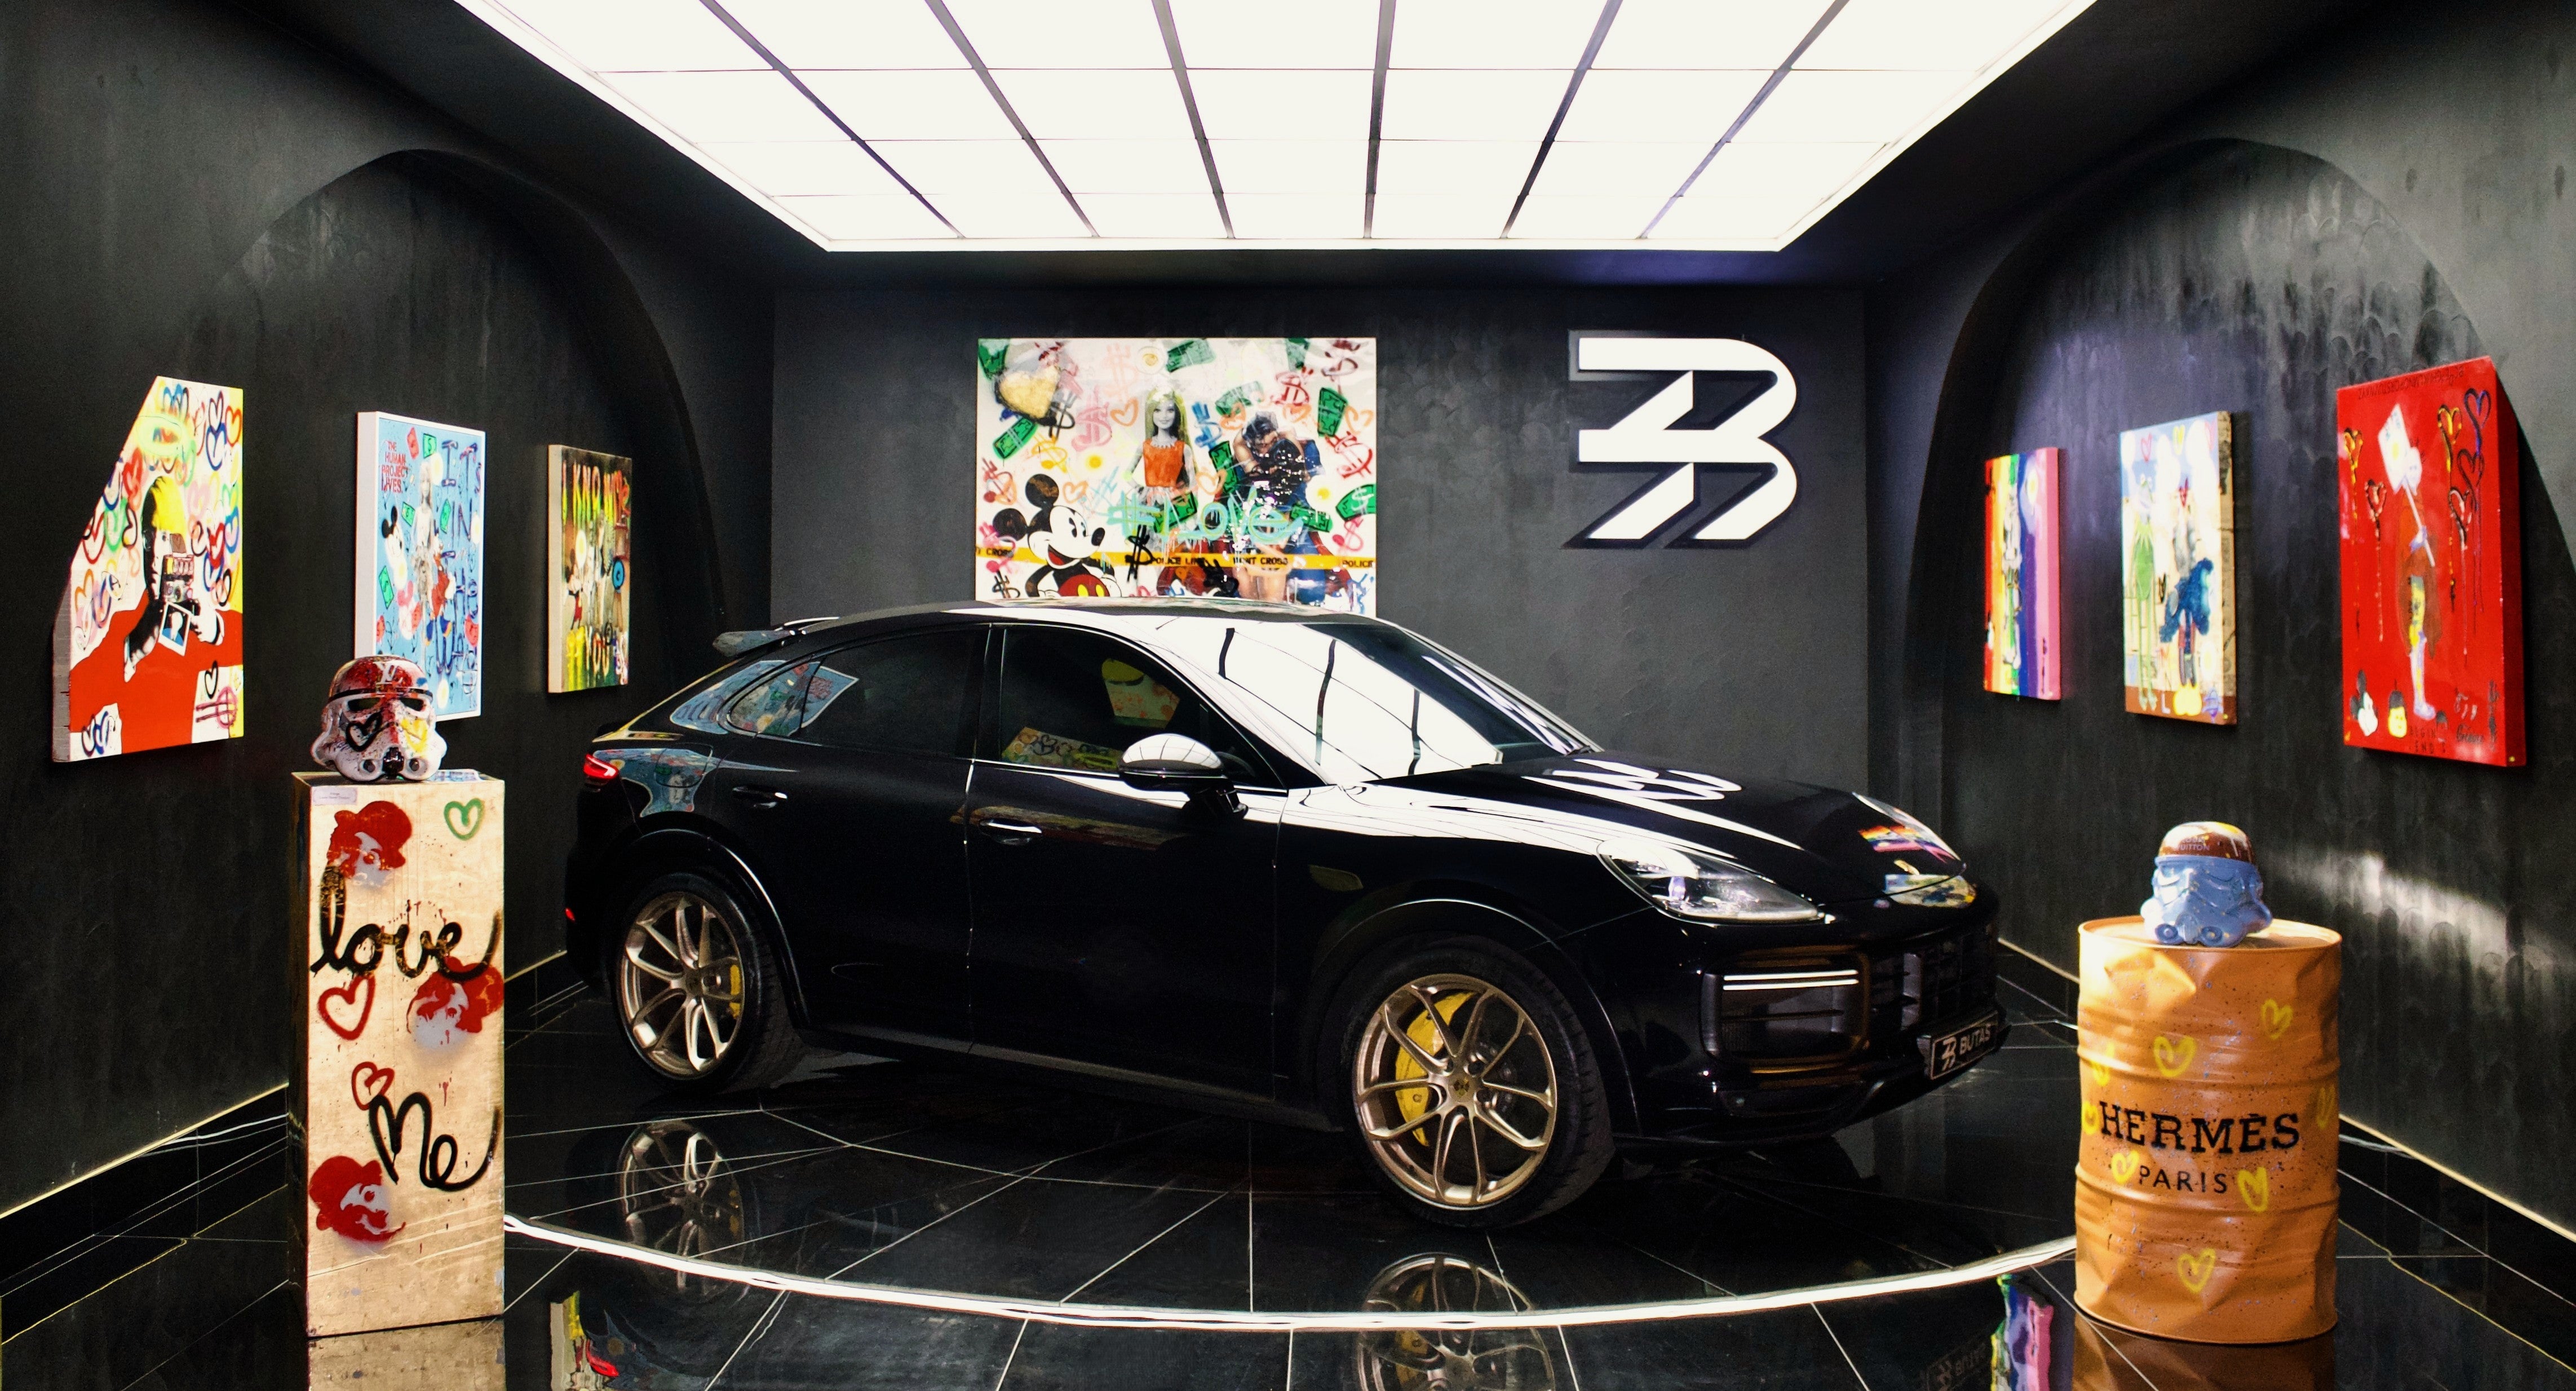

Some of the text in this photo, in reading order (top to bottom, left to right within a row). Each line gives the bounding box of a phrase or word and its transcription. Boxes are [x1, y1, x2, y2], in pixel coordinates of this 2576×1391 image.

[387, 440, 397, 452] THE
[385, 452, 406, 466] HUMAN
[382, 465, 409, 478] PROJECT
[1960, 1023, 1991, 1056] BUTAS
[2139, 1165, 2228, 1194] PARIS
